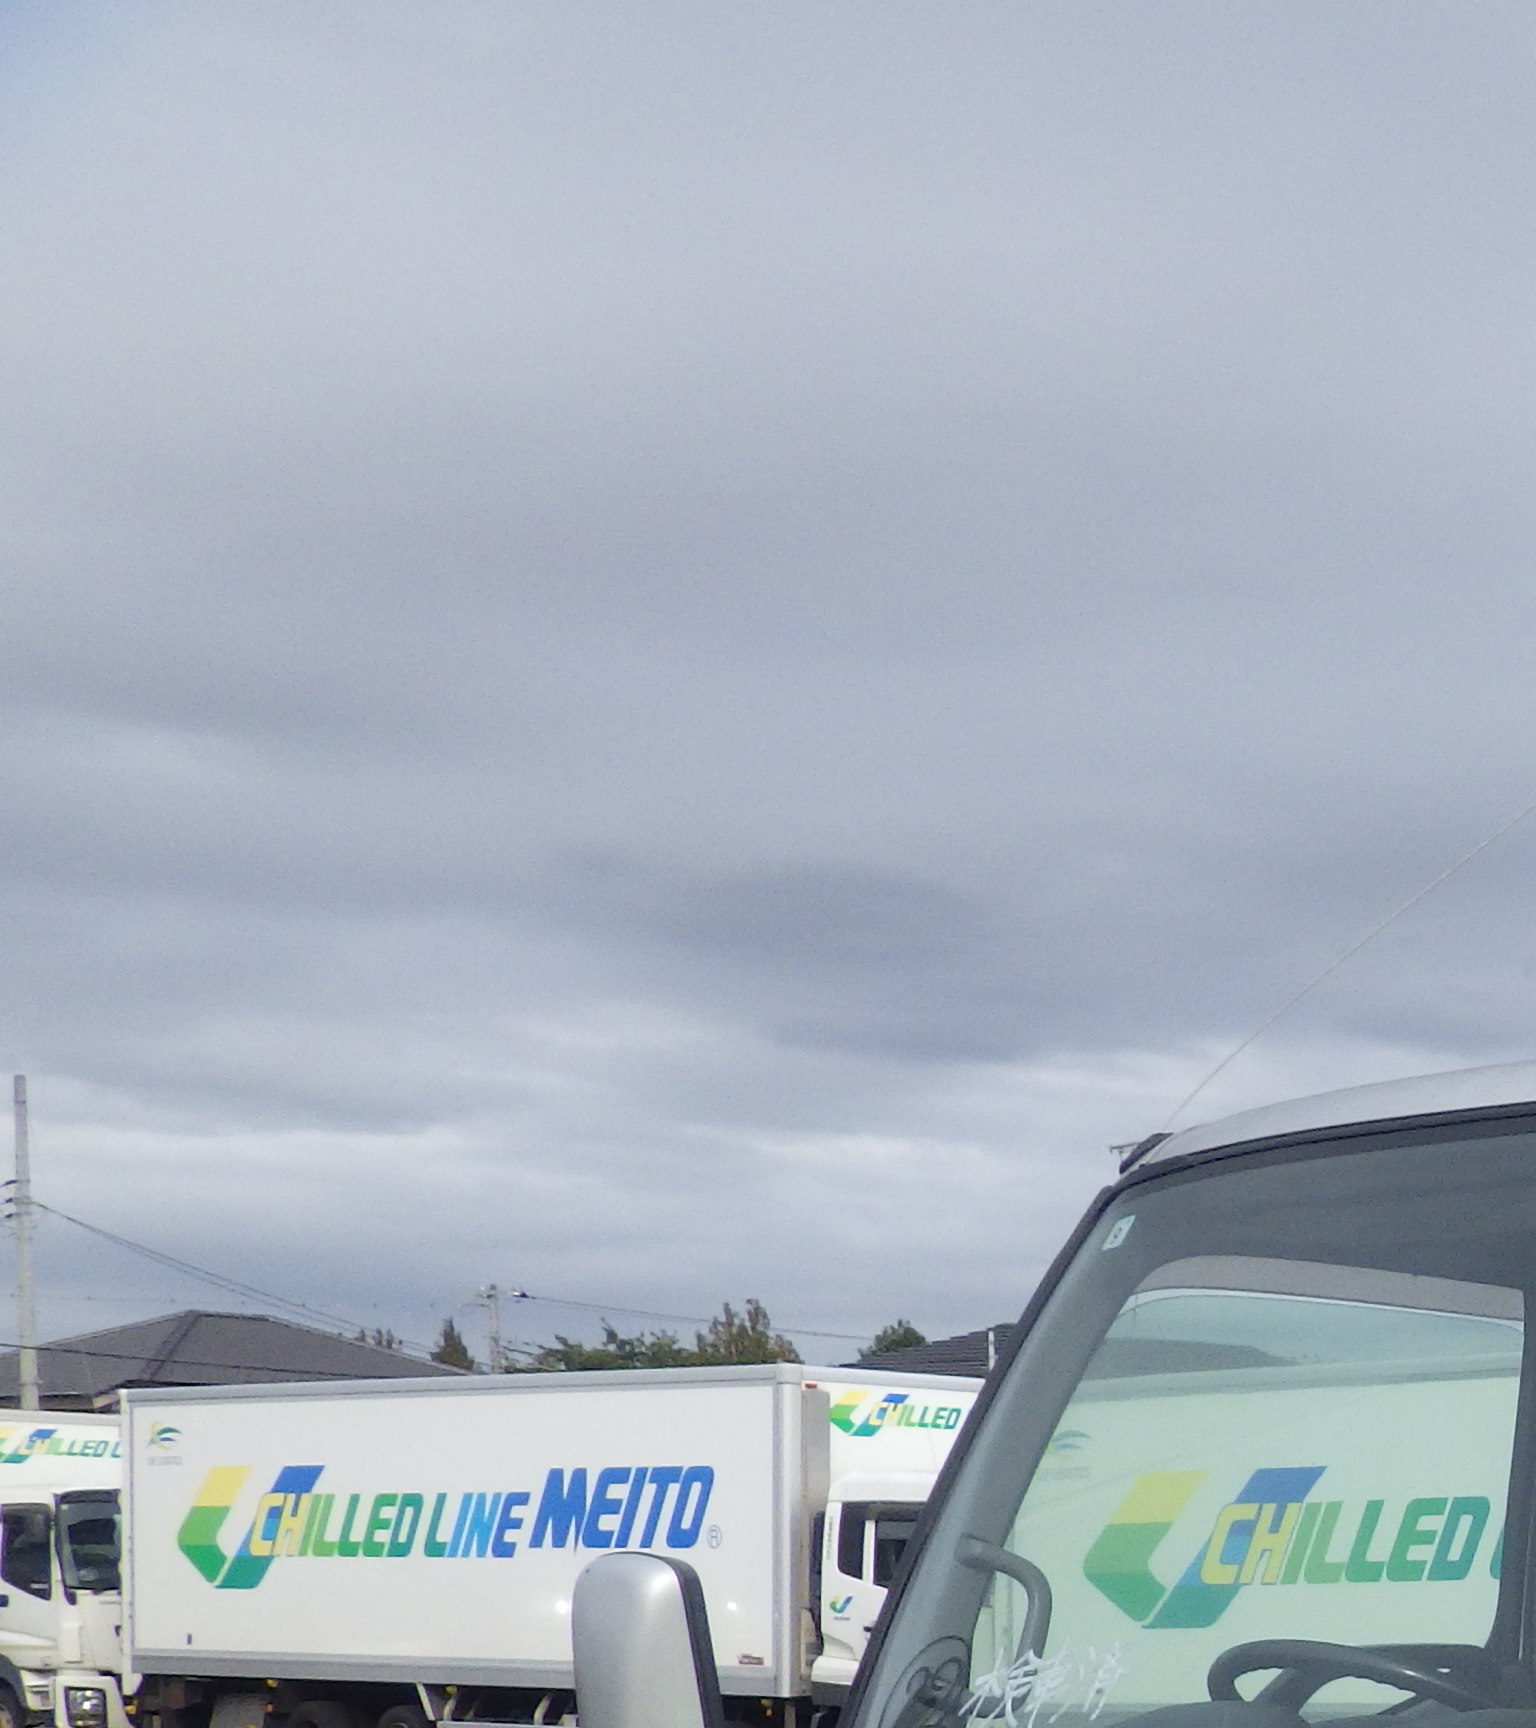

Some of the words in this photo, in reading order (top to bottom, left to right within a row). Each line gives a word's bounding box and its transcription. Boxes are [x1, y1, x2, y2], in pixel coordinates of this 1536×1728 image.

[868, 1403, 962, 1430] CHILLED
[249, 1491, 424, 1558] CHILLED
[423, 1491, 531, 1558] LINE
[528, 1465, 715, 1552] MEITO
[1200, 1495, 1491, 1586] CHILLED
